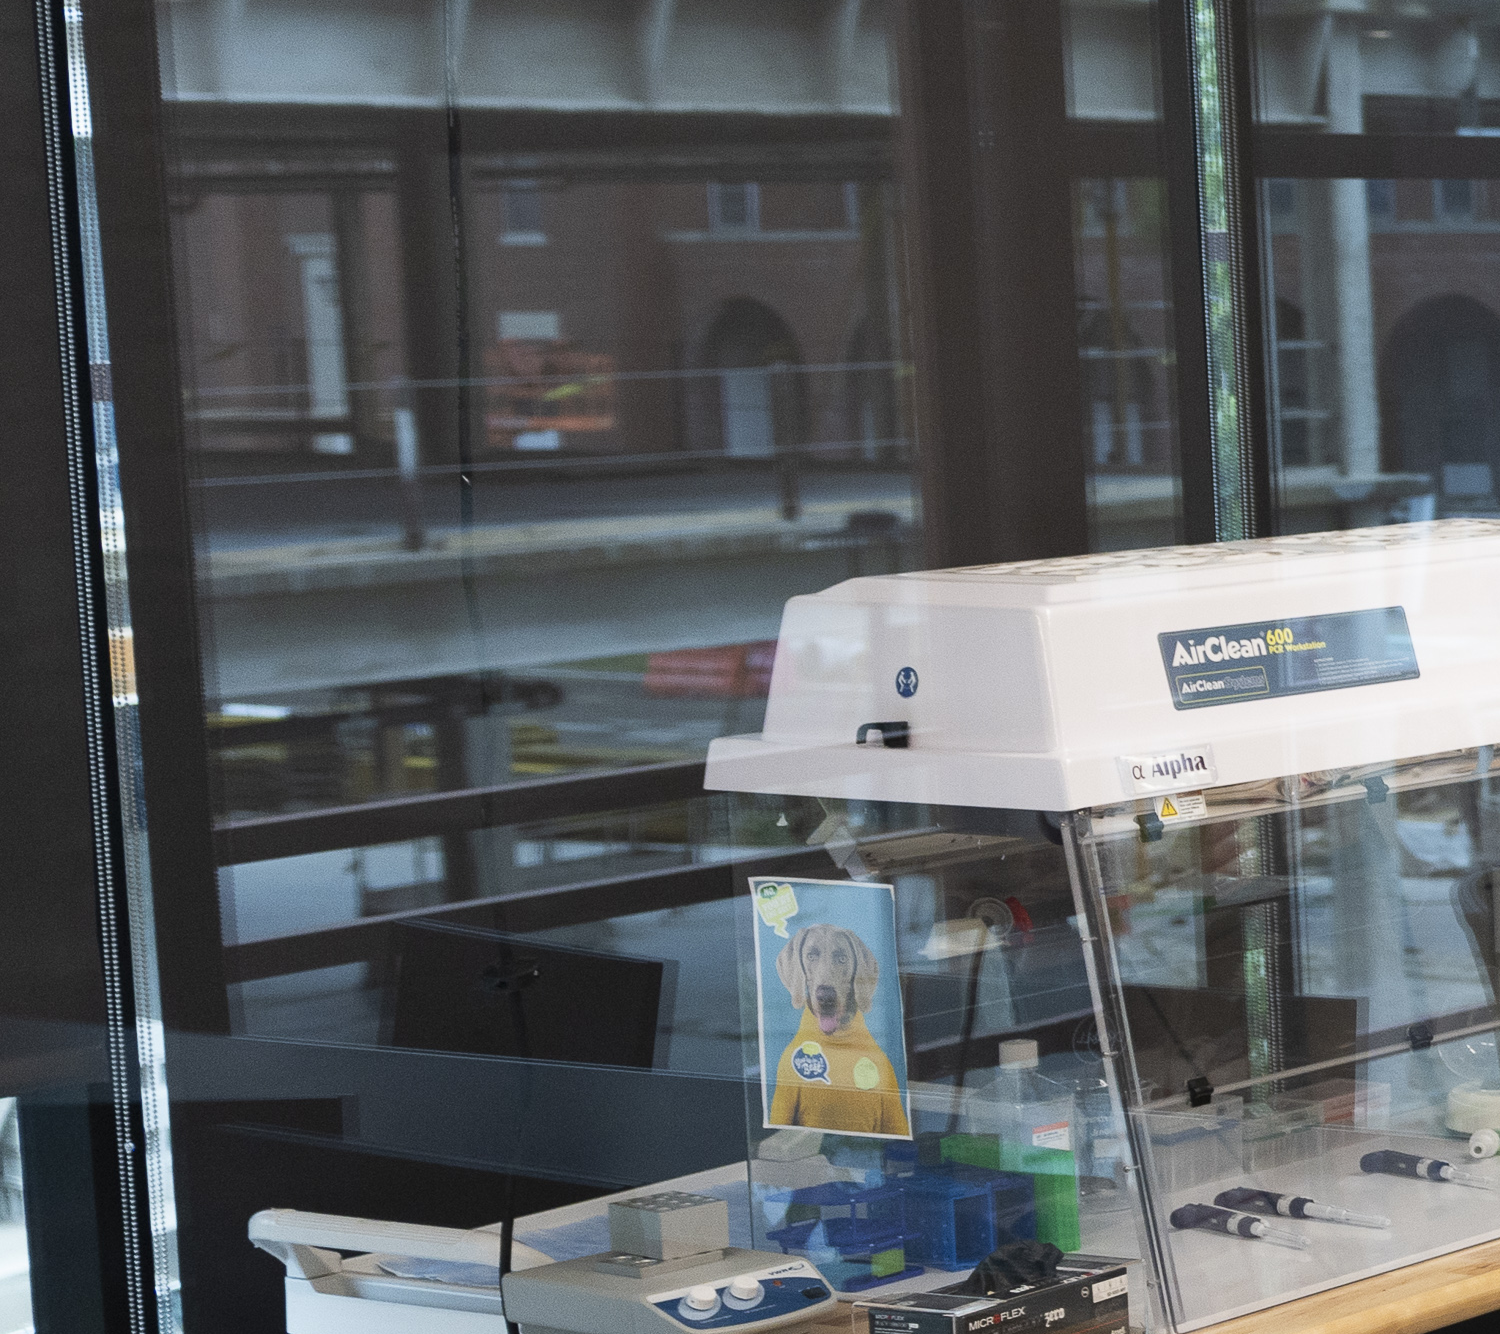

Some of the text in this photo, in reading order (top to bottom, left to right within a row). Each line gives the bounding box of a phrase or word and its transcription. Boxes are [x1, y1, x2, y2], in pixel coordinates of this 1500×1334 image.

[1172, 628, 1294, 667] AirClean 600
[1268, 641, 1327, 655] PCR Workstation
[1151, 752, 1208, 780] Alpha
[768, 1268, 788, 1276] VWR
